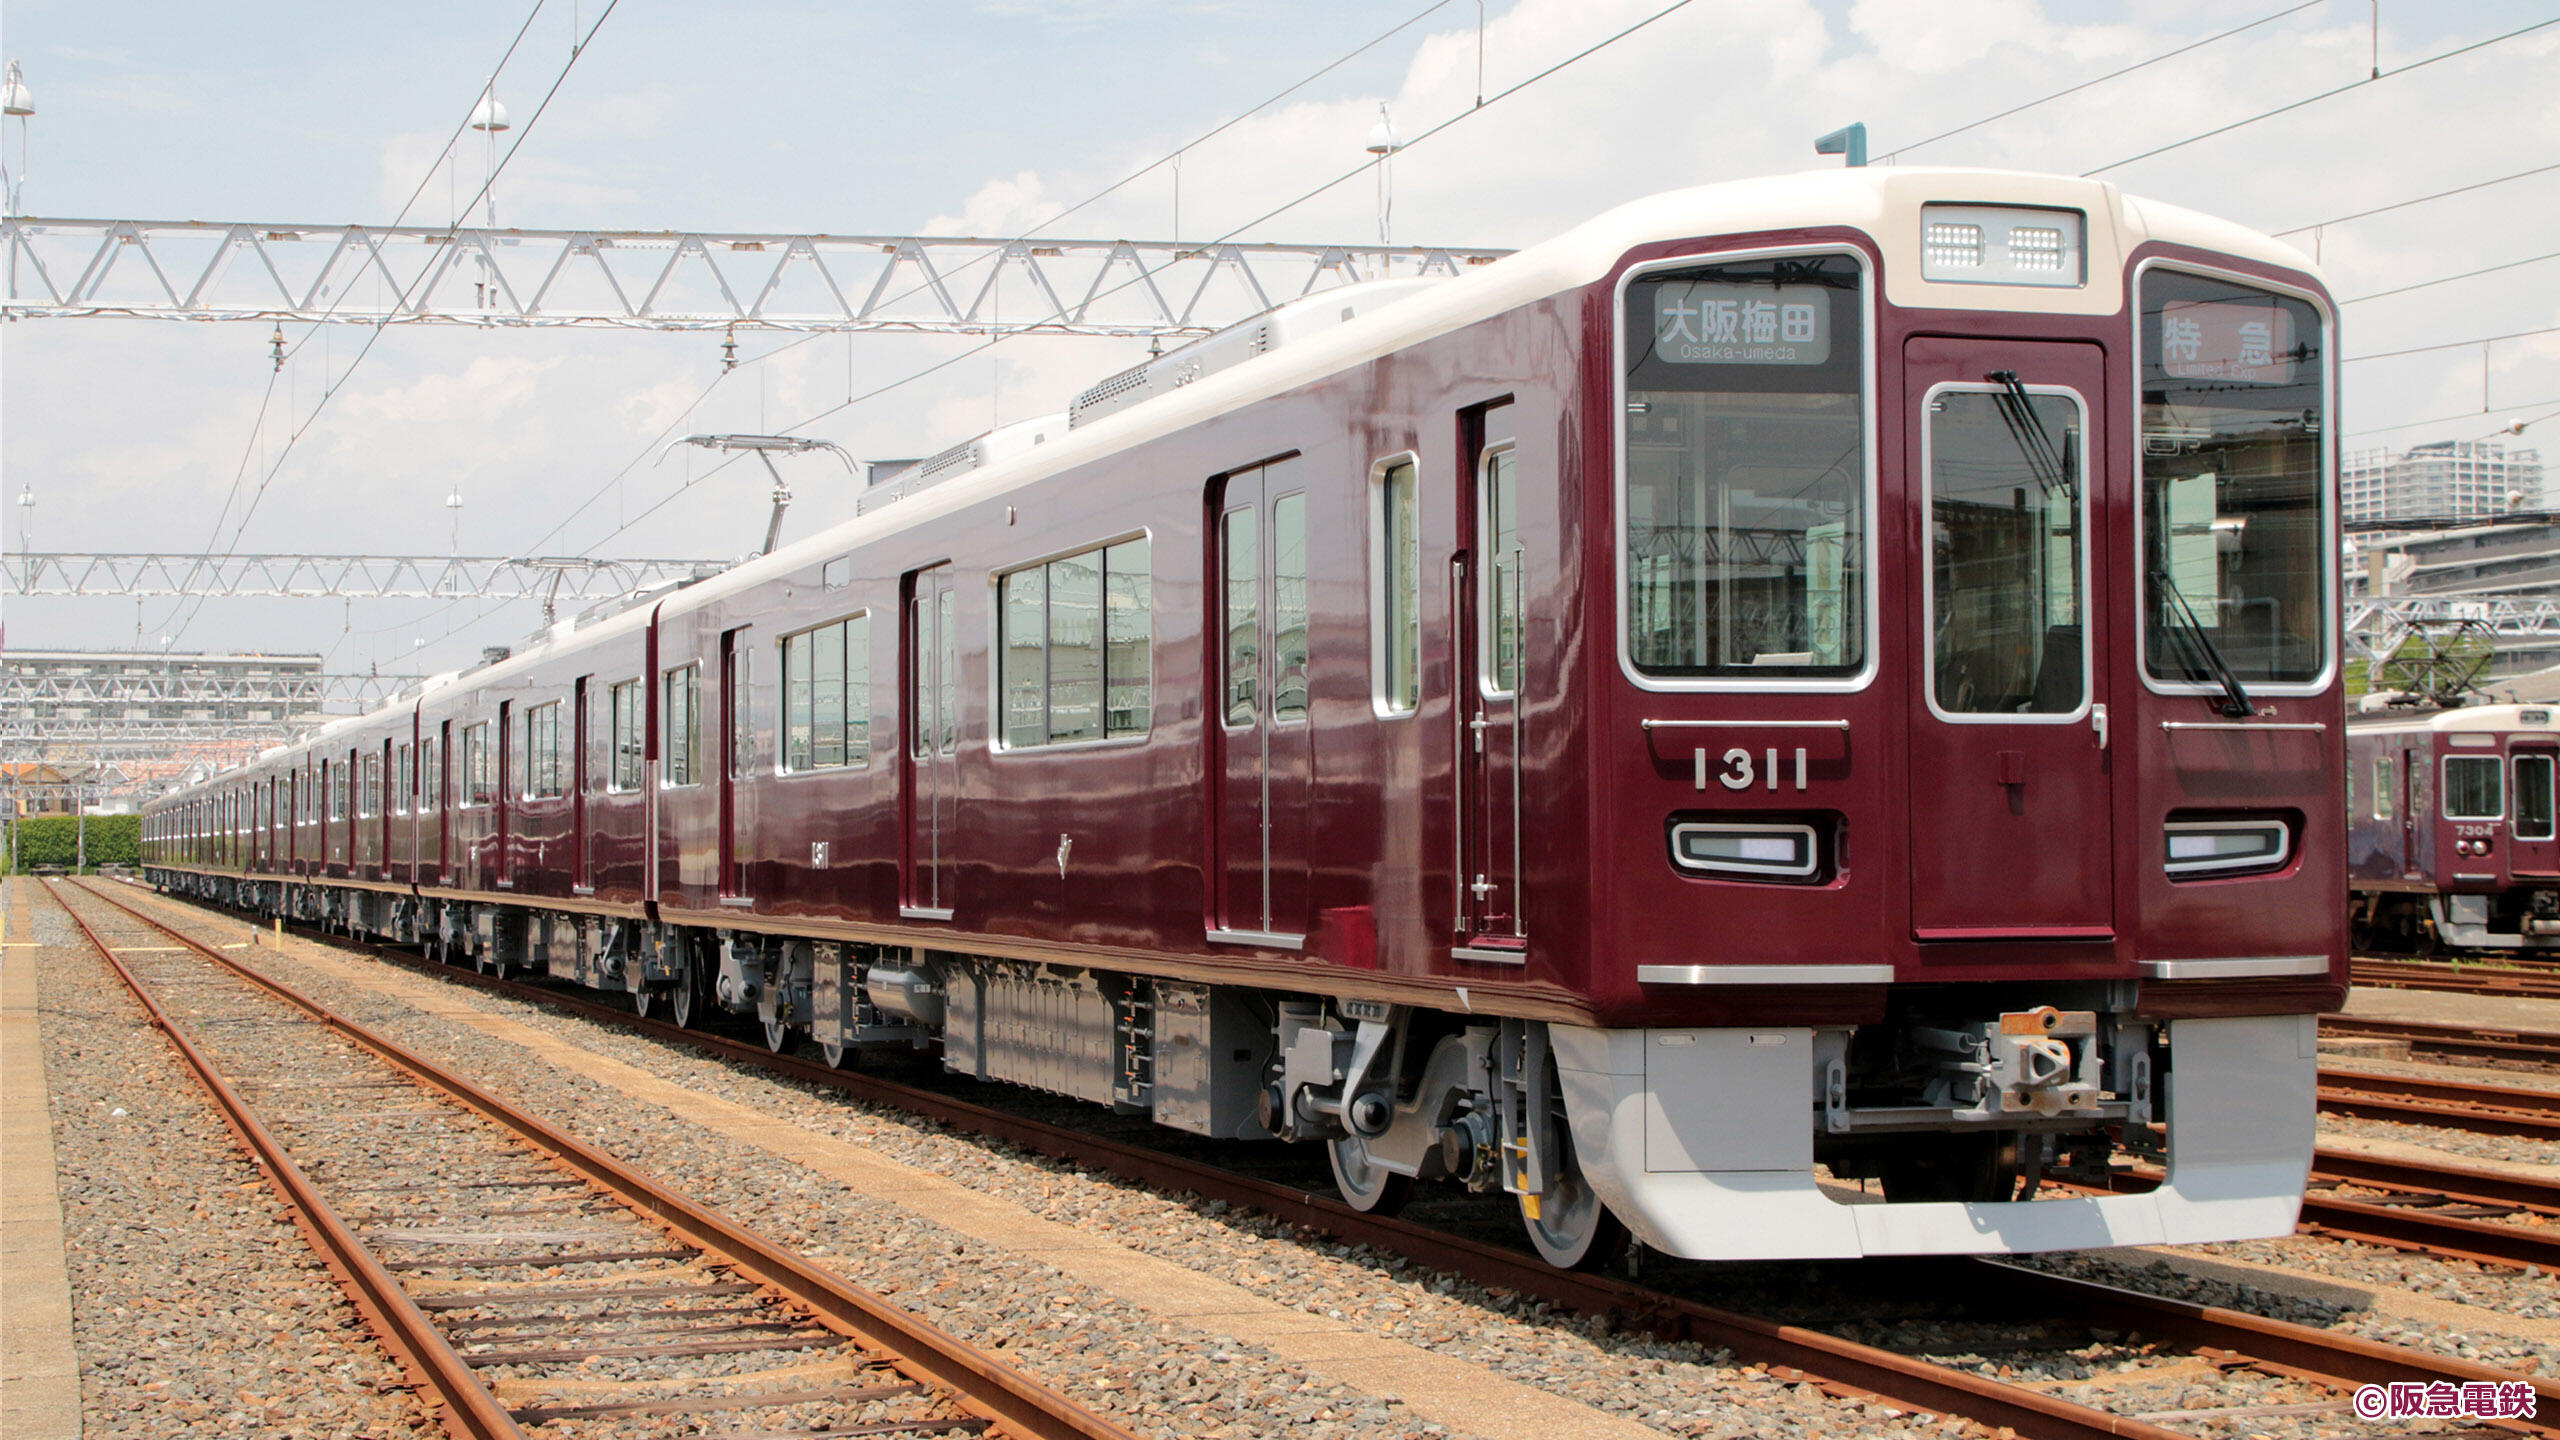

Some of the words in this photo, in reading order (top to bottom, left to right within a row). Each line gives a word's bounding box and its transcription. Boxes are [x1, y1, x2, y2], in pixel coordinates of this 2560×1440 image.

[1662, 298, 1815, 344] 大阪梅田
[1679, 344, 1798, 361] Osaka-umeda
[1694, 747, 1807, 790] 1311
[2455, 825, 2494, 836] 7304
